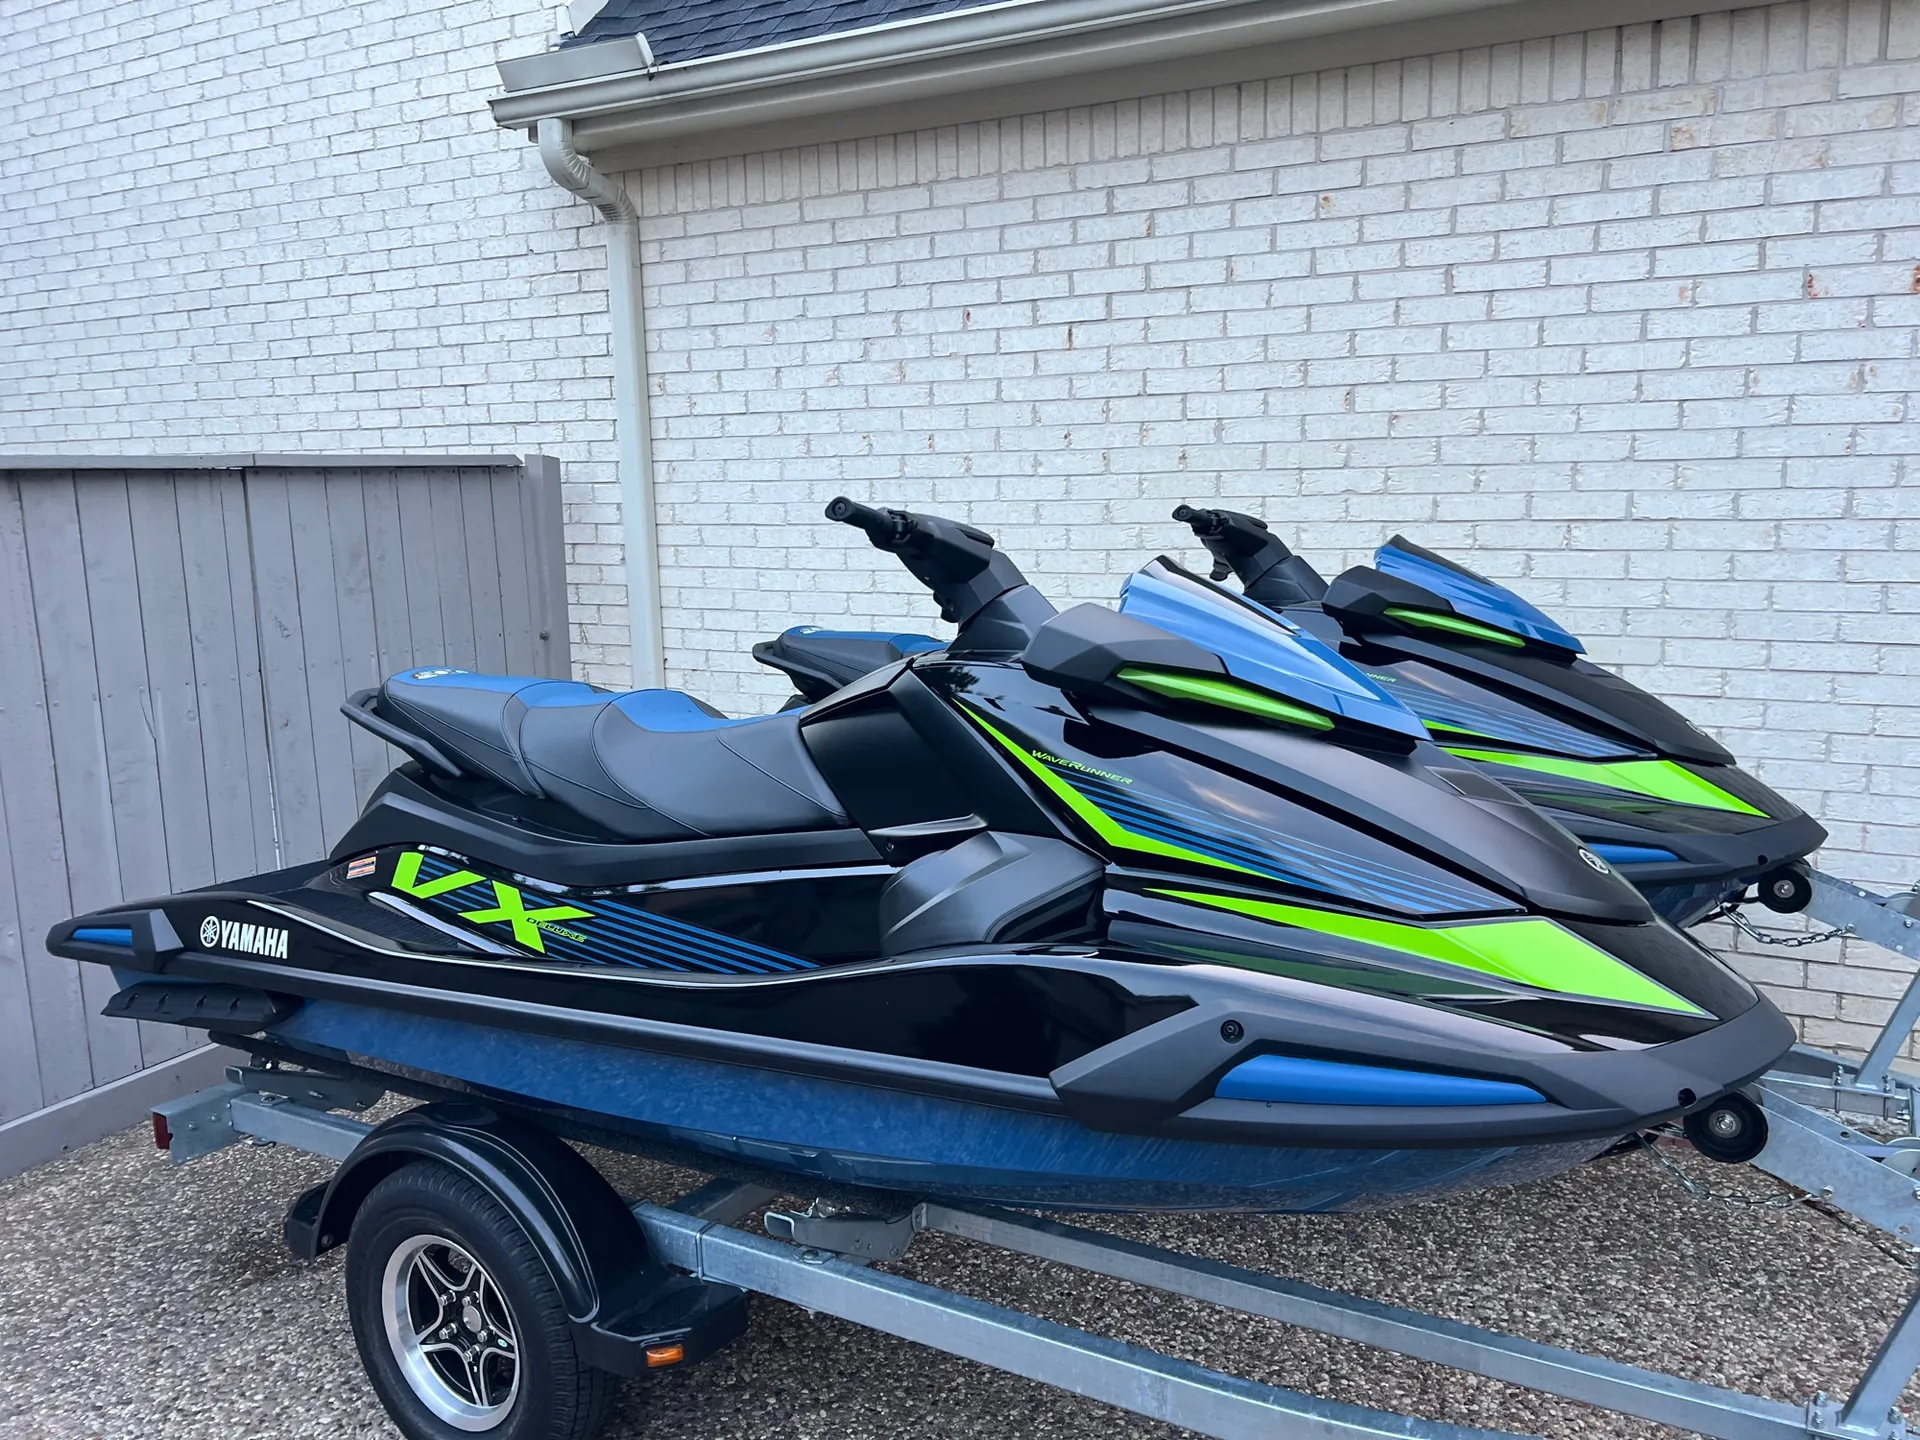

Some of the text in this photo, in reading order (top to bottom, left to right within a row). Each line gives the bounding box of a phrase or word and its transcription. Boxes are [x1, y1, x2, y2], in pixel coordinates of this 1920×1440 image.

[391, 851, 596, 954] VX
[221, 920, 289, 960] YAMAHA
[525, 917, 588, 943] DELUXE
